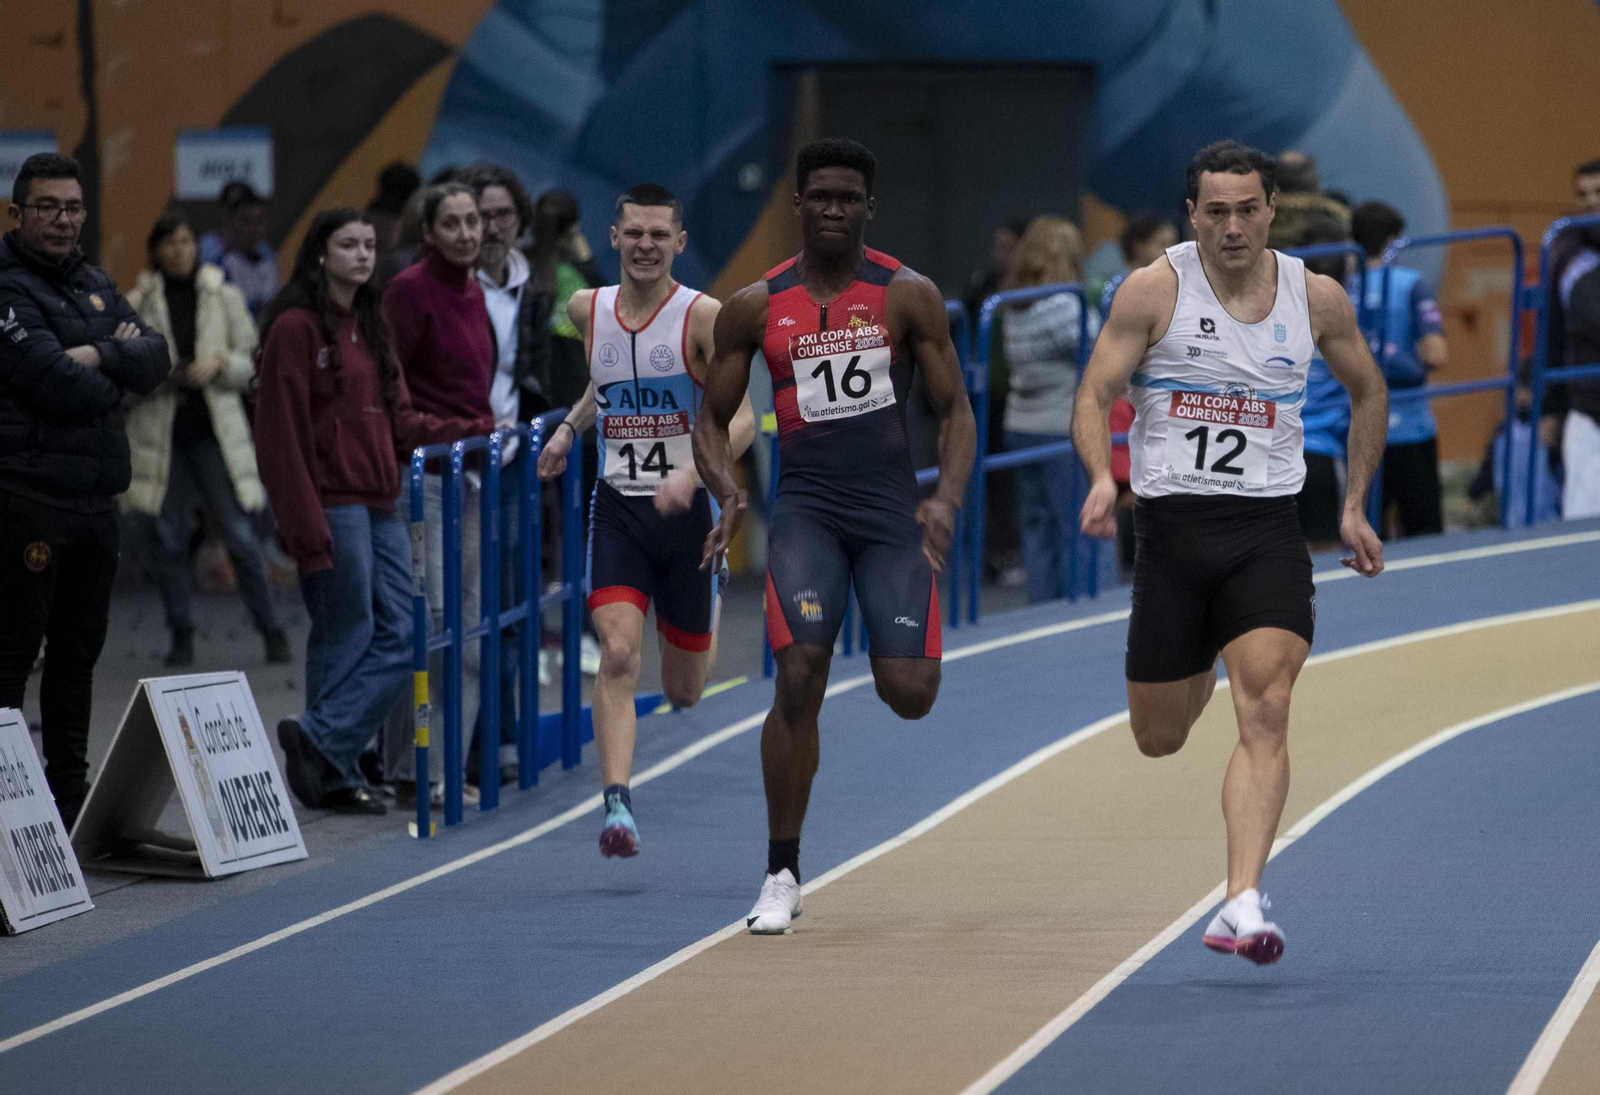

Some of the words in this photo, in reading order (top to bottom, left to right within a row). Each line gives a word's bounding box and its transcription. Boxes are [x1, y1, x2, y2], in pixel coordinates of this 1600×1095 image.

[797, 340, 853, 358] OURENSE
[855, 335, 885, 350] 2026
[798, 334, 817, 346] XXI
[820, 329, 853, 343] COPA
[856, 325, 879, 337] ABS
[811, 355, 872, 403] 16
[595, 380, 679, 409] SADA
[1181, 392, 1201, 406] XXI
[1204, 396, 1239, 411] COPA
[1241, 401, 1266, 414] ABS
[820, 399, 870, 416] atletismo.gal
[1176, 404, 1235, 423] OURENSE
[1238, 413, 1269, 427] 2026
[607, 426, 655, 438] OURENSE
[657, 424, 684, 437] 2026
[608, 416, 623, 427] XXI
[626, 415, 655, 427] COPA
[658, 413, 680, 425] ABS
[618, 441, 675, 480] 14
[1185, 425, 1248, 476] 12
[622, 483, 657, 492] atletismo.
[1181, 473, 1237, 490] atletismo.gal
[194, 702, 240, 755] Concello
[229, 701, 252, 749] de
[11, 745, 35, 797] de
[218, 770, 290, 843] OURENSE
[10, 821, 77, 898] OURENSE
